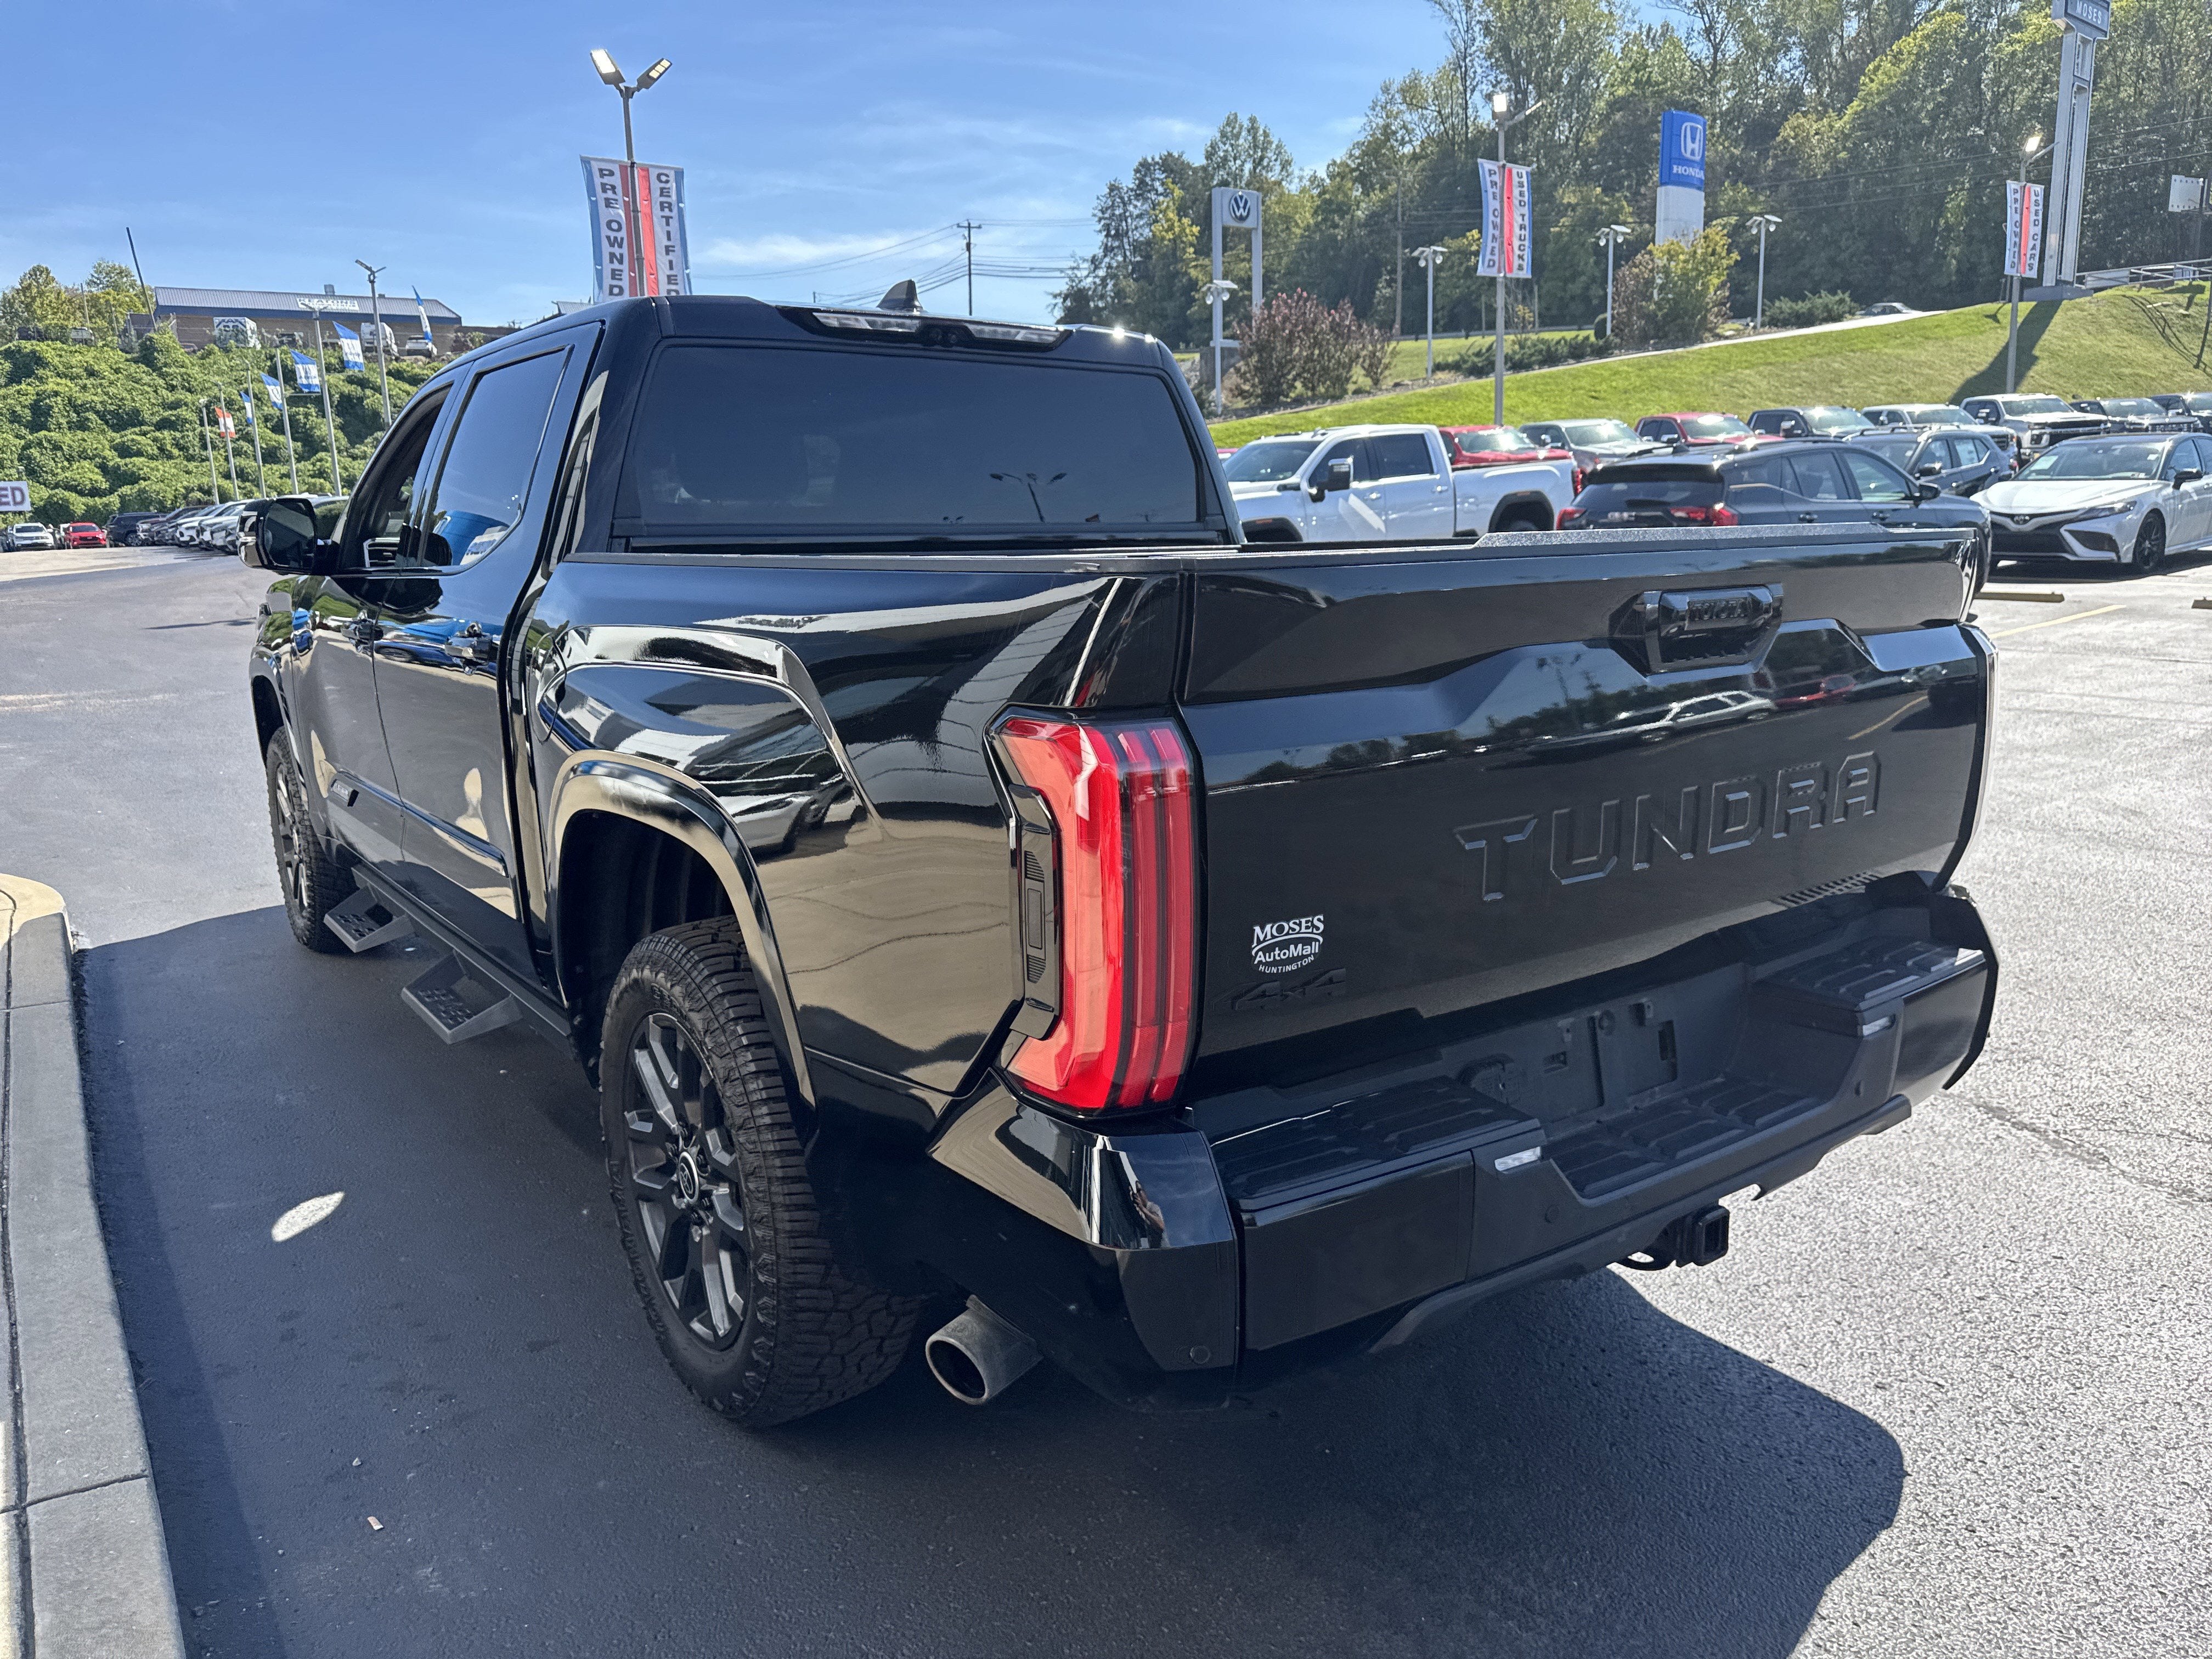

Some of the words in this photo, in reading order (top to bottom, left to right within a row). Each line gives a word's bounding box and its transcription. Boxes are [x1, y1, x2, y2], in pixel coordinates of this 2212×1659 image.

[2076, 0, 2102, 24] MOSES
[598, 167, 619, 210] PRE
[1488, 168, 1498, 200] PRE
[1516, 171, 1527, 207] USED
[1672, 165, 1705, 180] HONDA
[1487, 208, 1499, 268] OWNED
[1517, 213, 1527, 272] TRUCKS
[2027, 233, 2039, 272] CARS
[605, 219, 624, 297] OWNED
[1453, 750, 1882, 901] TUNDRA
[1252, 915, 1324, 948] MOSES
[1254, 941, 1319, 964] AutoMall
[1259, 955, 1314, 974] HUNTINGTON
